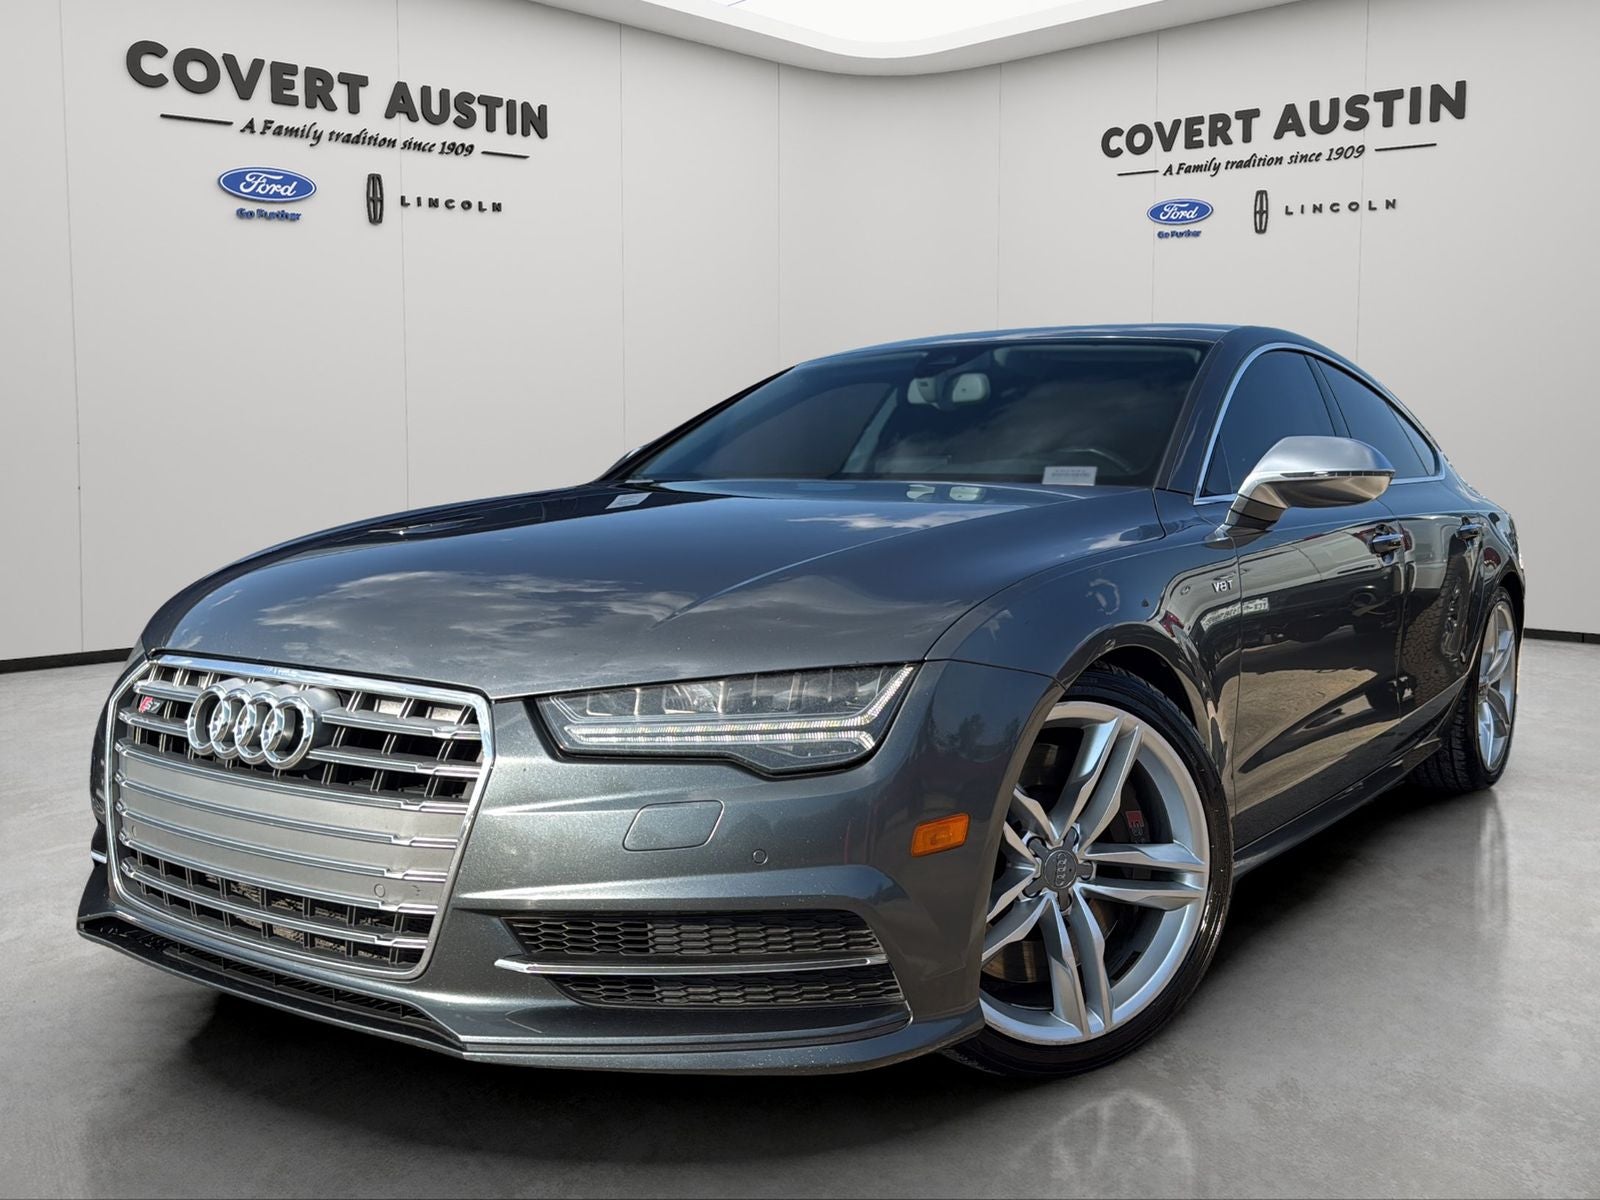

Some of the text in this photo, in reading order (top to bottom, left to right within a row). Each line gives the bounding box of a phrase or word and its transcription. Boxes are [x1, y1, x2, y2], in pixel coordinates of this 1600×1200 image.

[126, 40, 549, 140] COVERT AUSTIN
[1101, 80, 1467, 158] COVERT AUSTIN
[240, 118, 475, 156] A Family tradition since 1909
[1163, 144, 1365, 177] A Family tradition since 1909
[239, 171, 298, 196] Ford
[400, 195, 502, 212] LINCOLN
[1160, 203, 1199, 219] Ford
[1285, 198, 1396, 215] LINCOLN
[1211, 579, 1233, 593] V8T
